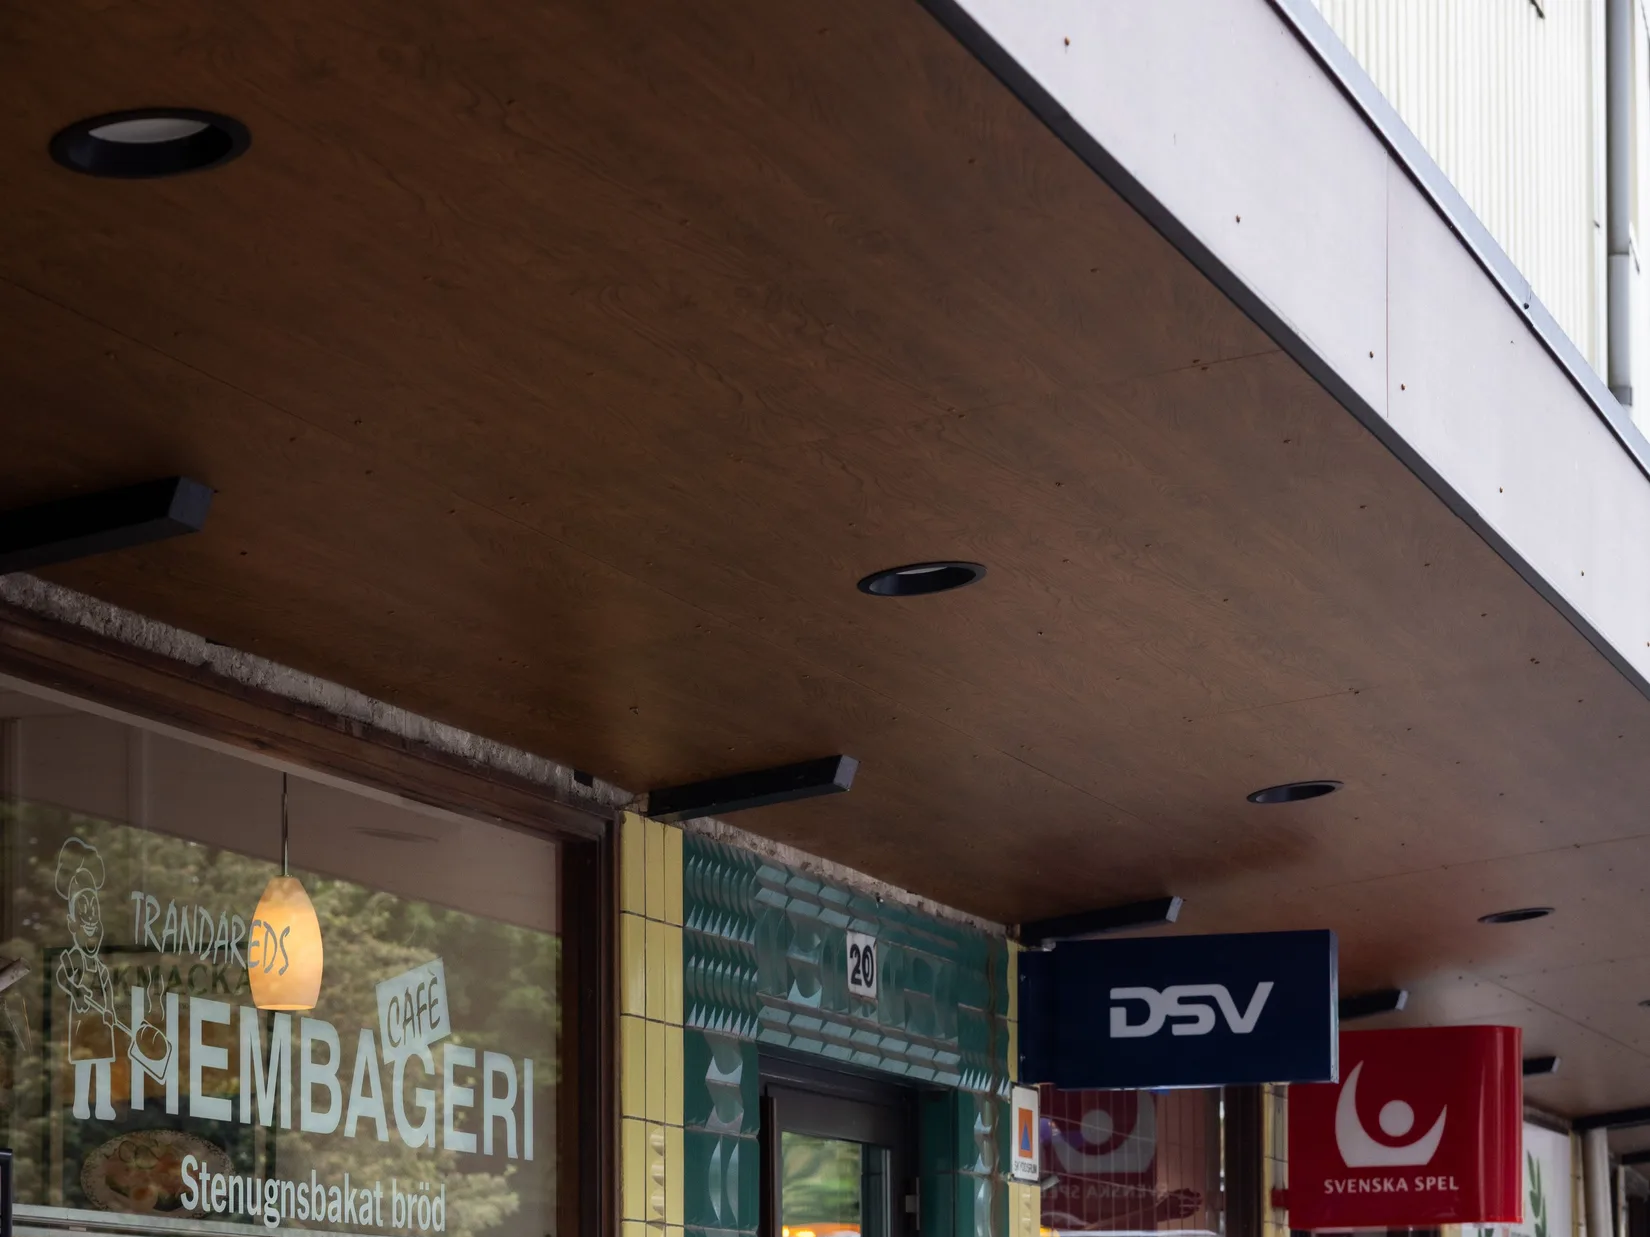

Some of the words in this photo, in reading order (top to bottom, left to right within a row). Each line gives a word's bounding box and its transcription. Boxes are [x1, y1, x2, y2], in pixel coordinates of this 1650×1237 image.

[131, 891, 290, 976] TRANDAREDS
[849, 943, 874, 988] 20
[1110, 981, 1274, 1038] DSV
[131, 986, 534, 1160] HEMBAGERI
[181, 1154, 384, 1228] Stenugnsbakat
[391, 1179, 446, 1232] bröd
[1323, 1176, 1408, 1195] SVENSKA
[1414, 1175, 1459, 1192] SPEL
